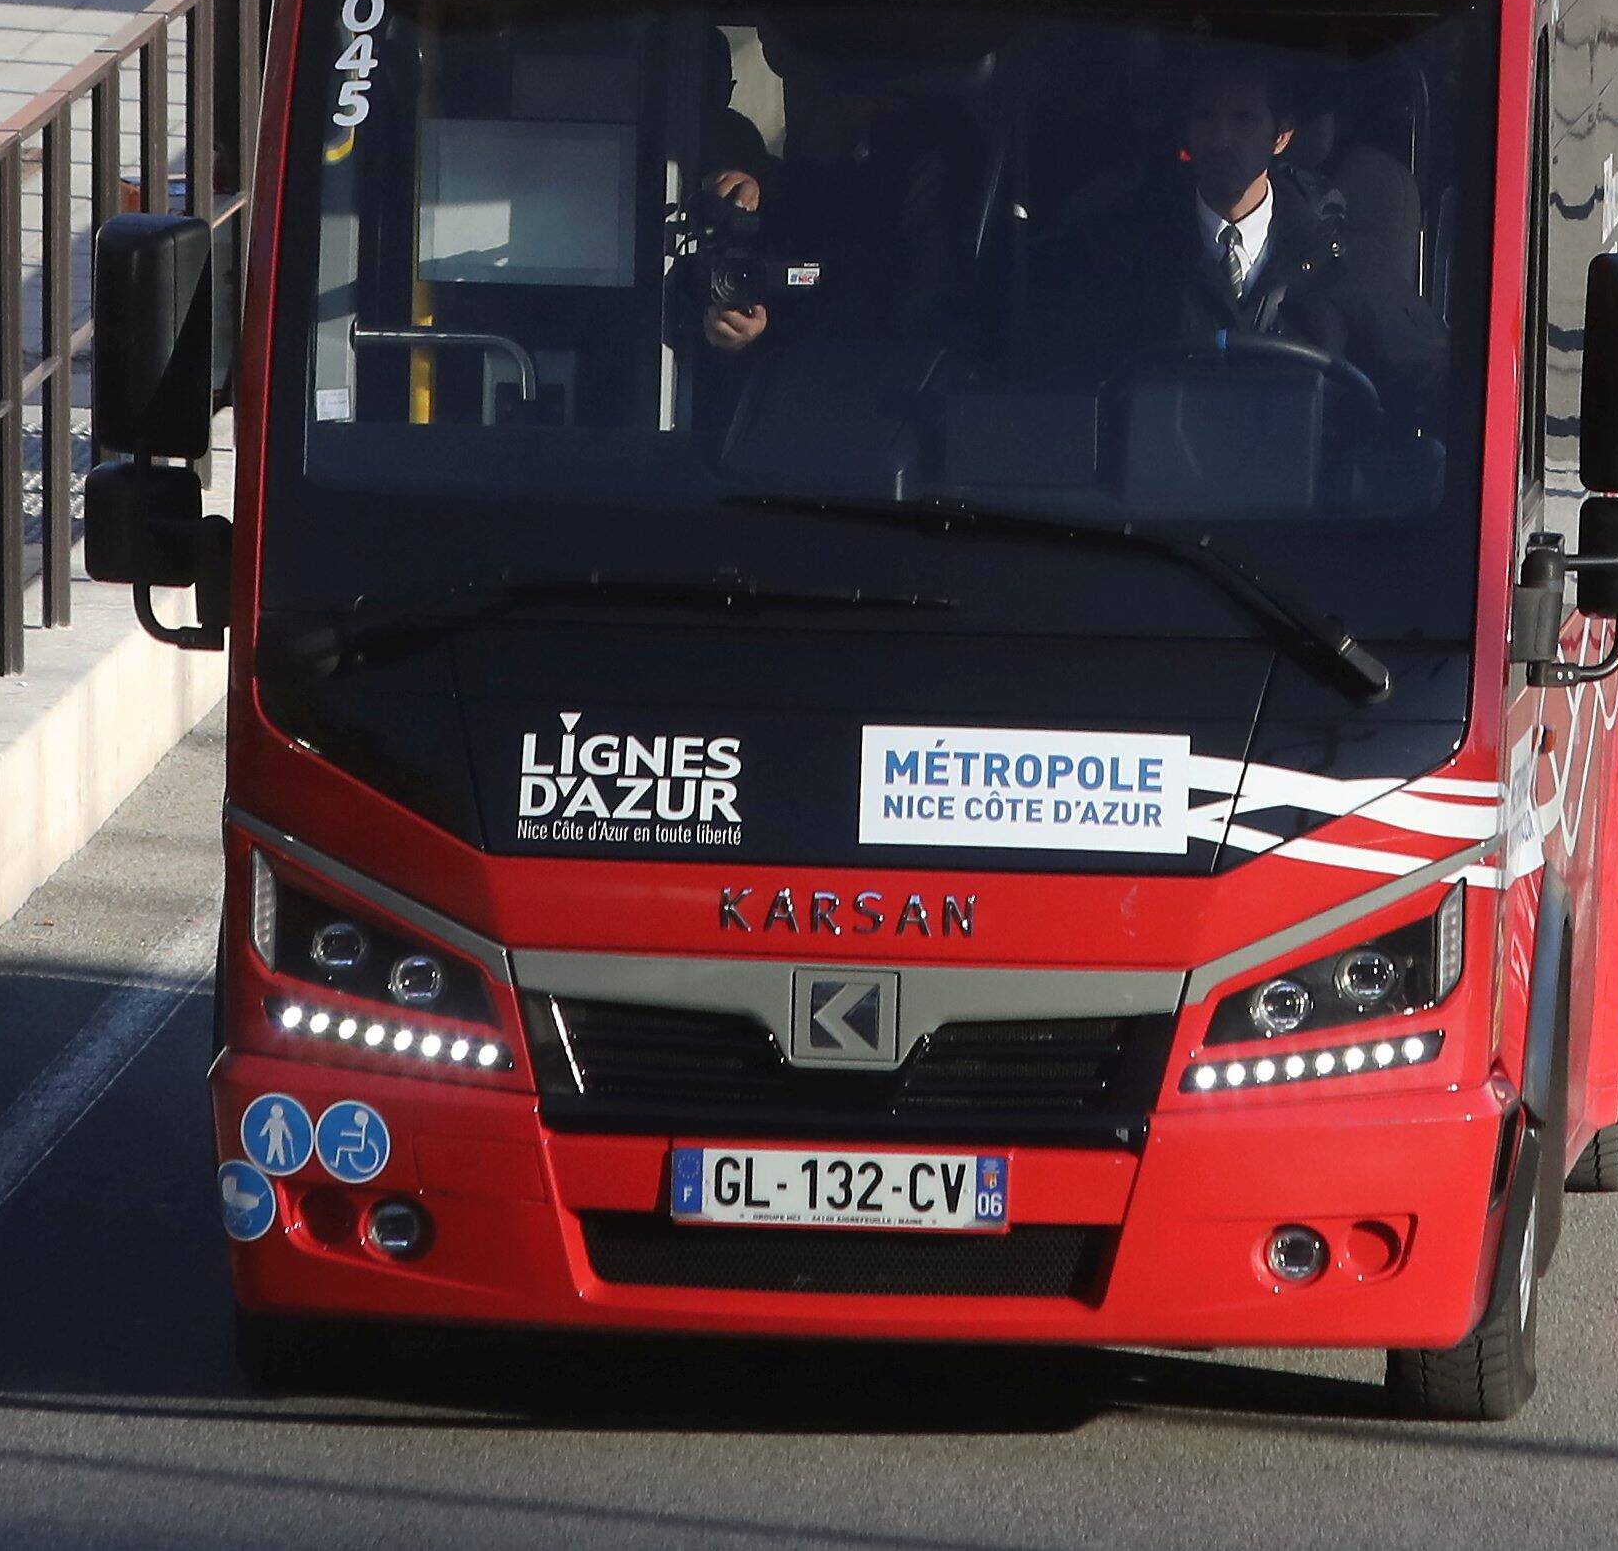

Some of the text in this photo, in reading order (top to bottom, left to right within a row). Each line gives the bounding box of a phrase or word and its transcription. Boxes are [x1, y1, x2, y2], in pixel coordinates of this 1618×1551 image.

[522, 712, 743, 780] LIGNES
[884, 739, 1164, 793] MÉTROPOLE
[518, 774, 743, 823] D'AZUR
[882, 789, 1164, 828] NICE CÔTE D'AZUR
[517, 820, 742, 846] Nice Côte d'Azur en toute liberté
[719, 887, 977, 938] KARSAN
[683, 1156, 1003, 1217] F GL-132-CV 06
